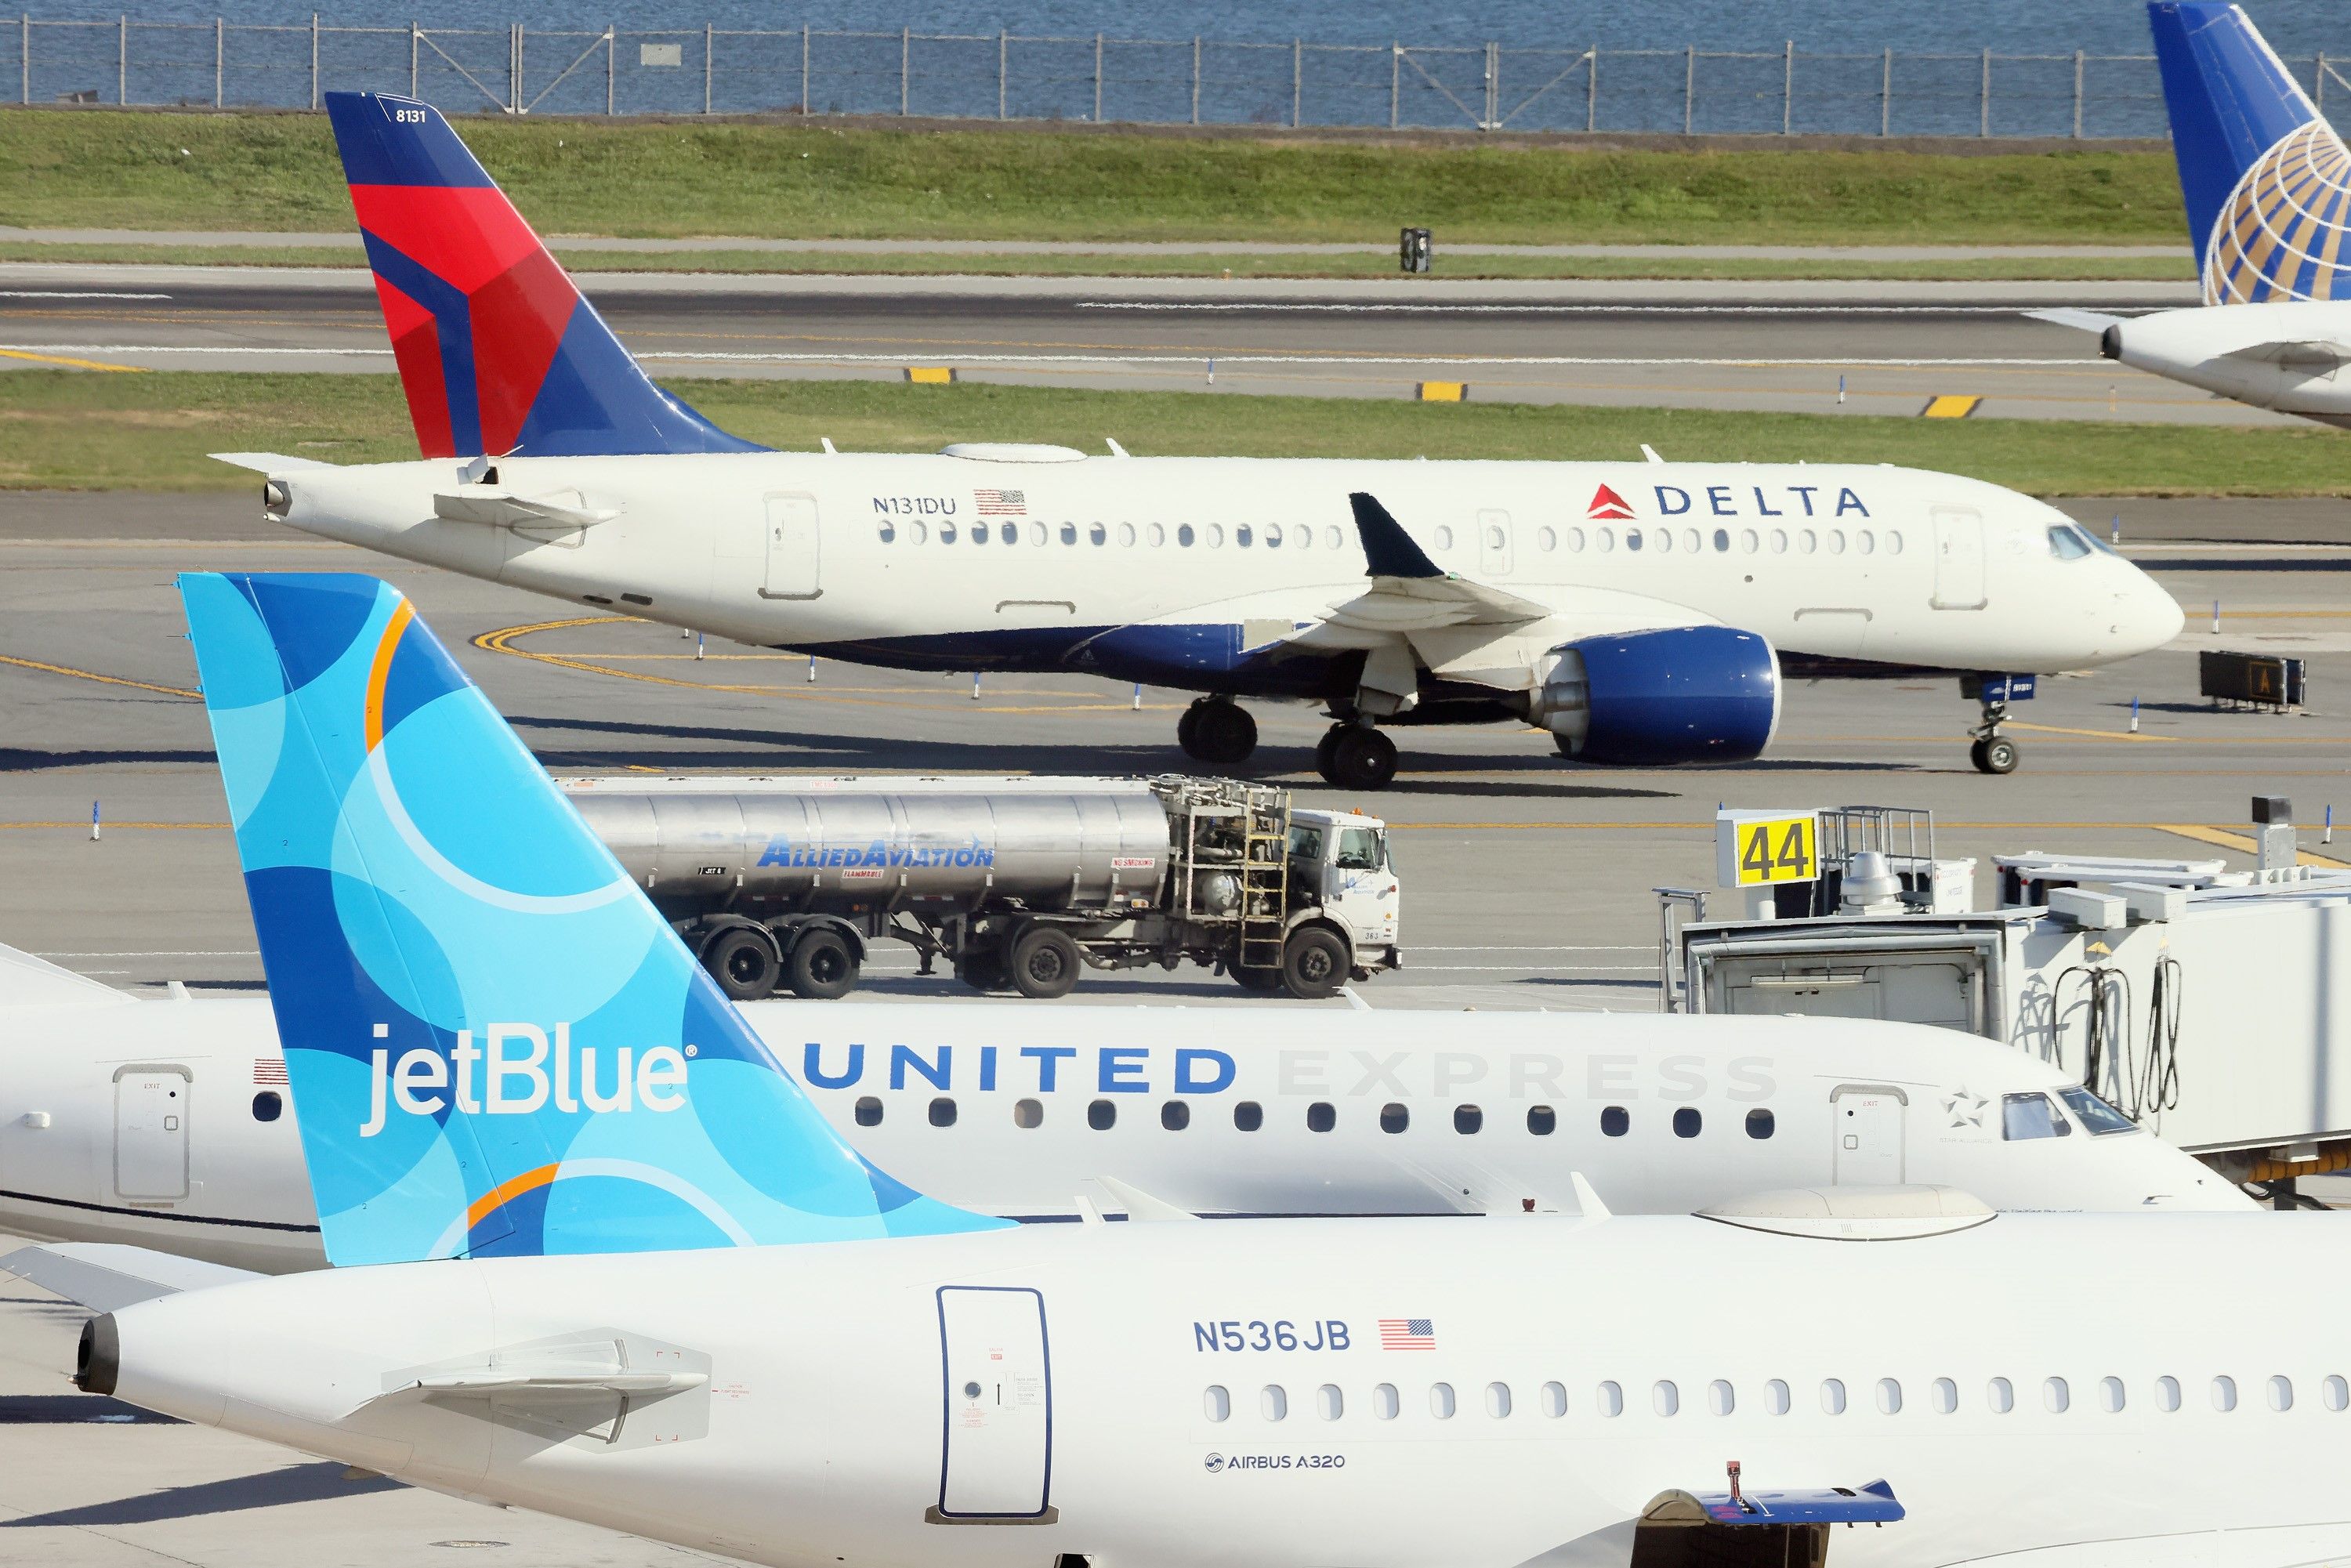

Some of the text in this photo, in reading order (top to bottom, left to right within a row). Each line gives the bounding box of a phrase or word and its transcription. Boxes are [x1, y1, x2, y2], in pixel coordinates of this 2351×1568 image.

[396, 110, 426, 123] 8131
[873, 497, 956, 514] N131DU
[1654, 486, 1870, 517] DELTA
[1743, 823, 1809, 880] 44
[1365, 932, 1379, 940] 363
[803, 1043, 1777, 1102] UNITED EXPRESS
[1194, 1320, 1350, 1352] N536JB
[1227, 1455, 1346, 1469] AIRBUS A320
